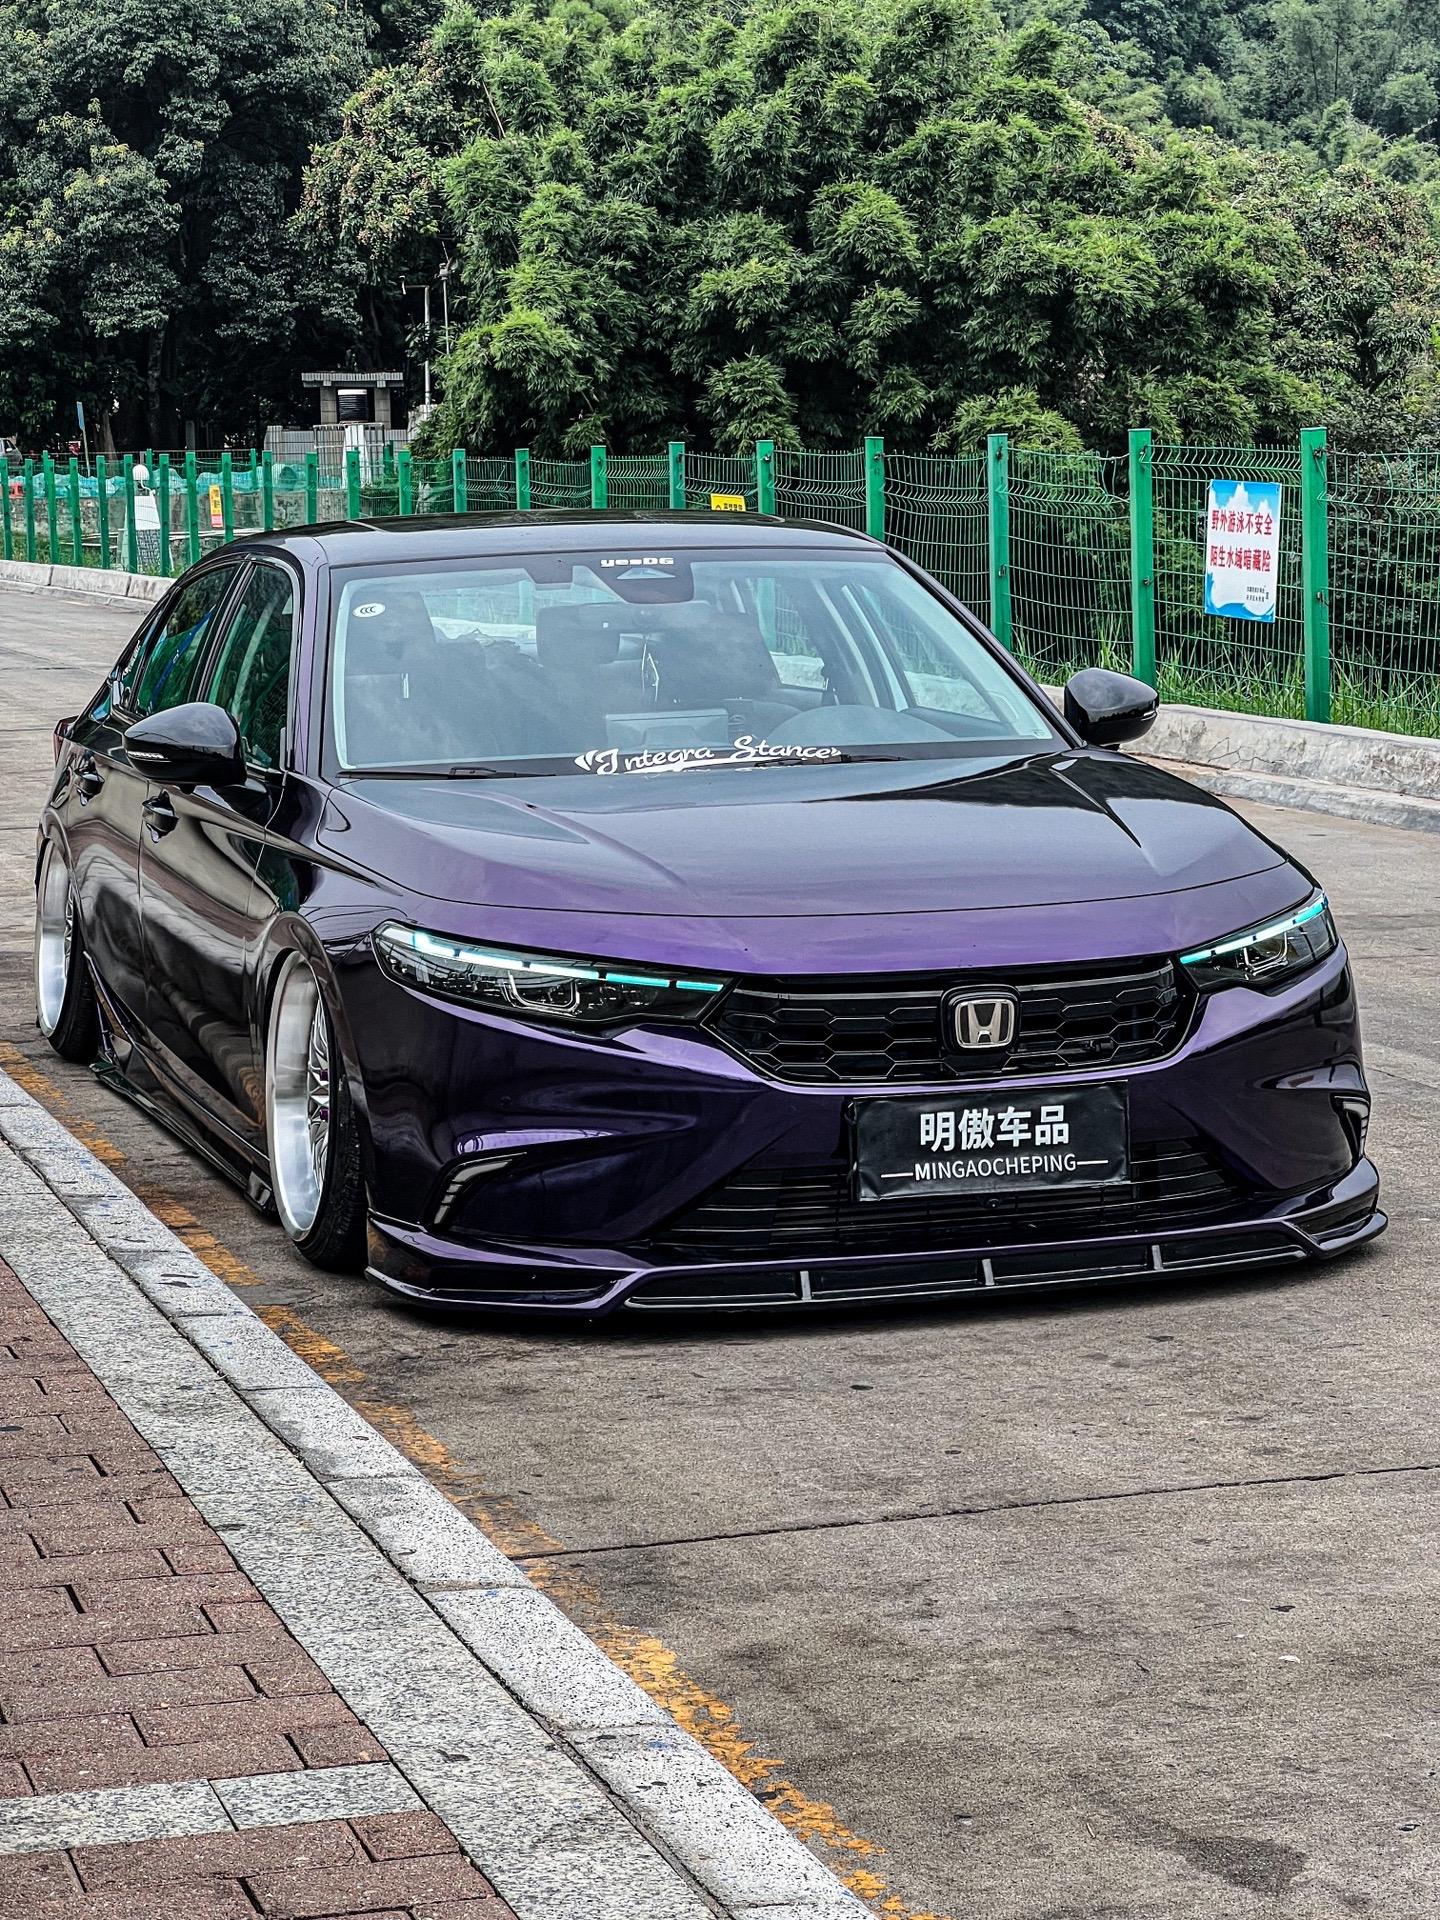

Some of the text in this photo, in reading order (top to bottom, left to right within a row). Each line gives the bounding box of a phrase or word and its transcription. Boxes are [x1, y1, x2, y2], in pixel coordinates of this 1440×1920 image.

[1211, 509, 1273, 536] 野外游泳不安全
[1209, 545, 1272, 573] 陌生水域暗藏险
[597, 735, 832, 775] Integra Stance
[919, 1104, 1070, 1152] 明傲车品
[914, 1153, 1077, 1181] MINGAOCHEPING
